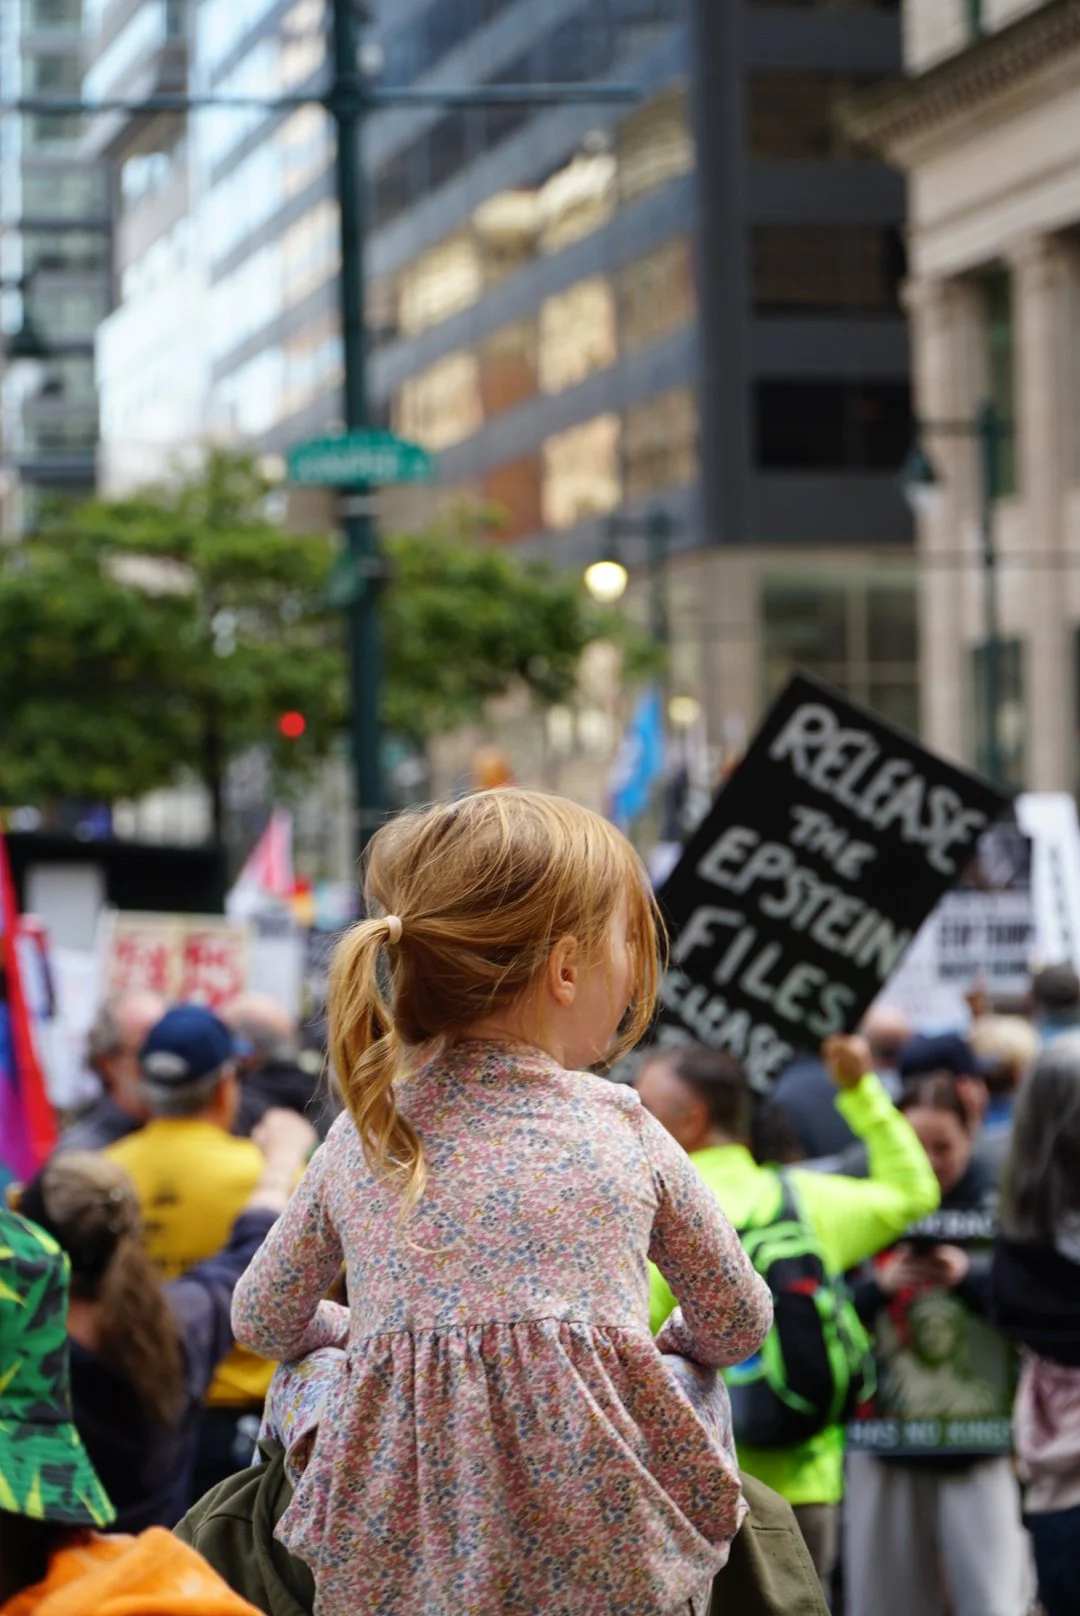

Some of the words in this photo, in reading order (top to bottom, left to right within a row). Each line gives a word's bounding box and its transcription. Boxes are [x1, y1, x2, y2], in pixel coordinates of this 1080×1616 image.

[769, 702, 987, 876] RELEASE
[791, 805, 878, 881] THE
[696, 826, 913, 981] EPSTEIN
[658, 968, 796, 1098] ELEASE
[672, 905, 857, 1036] FILES
